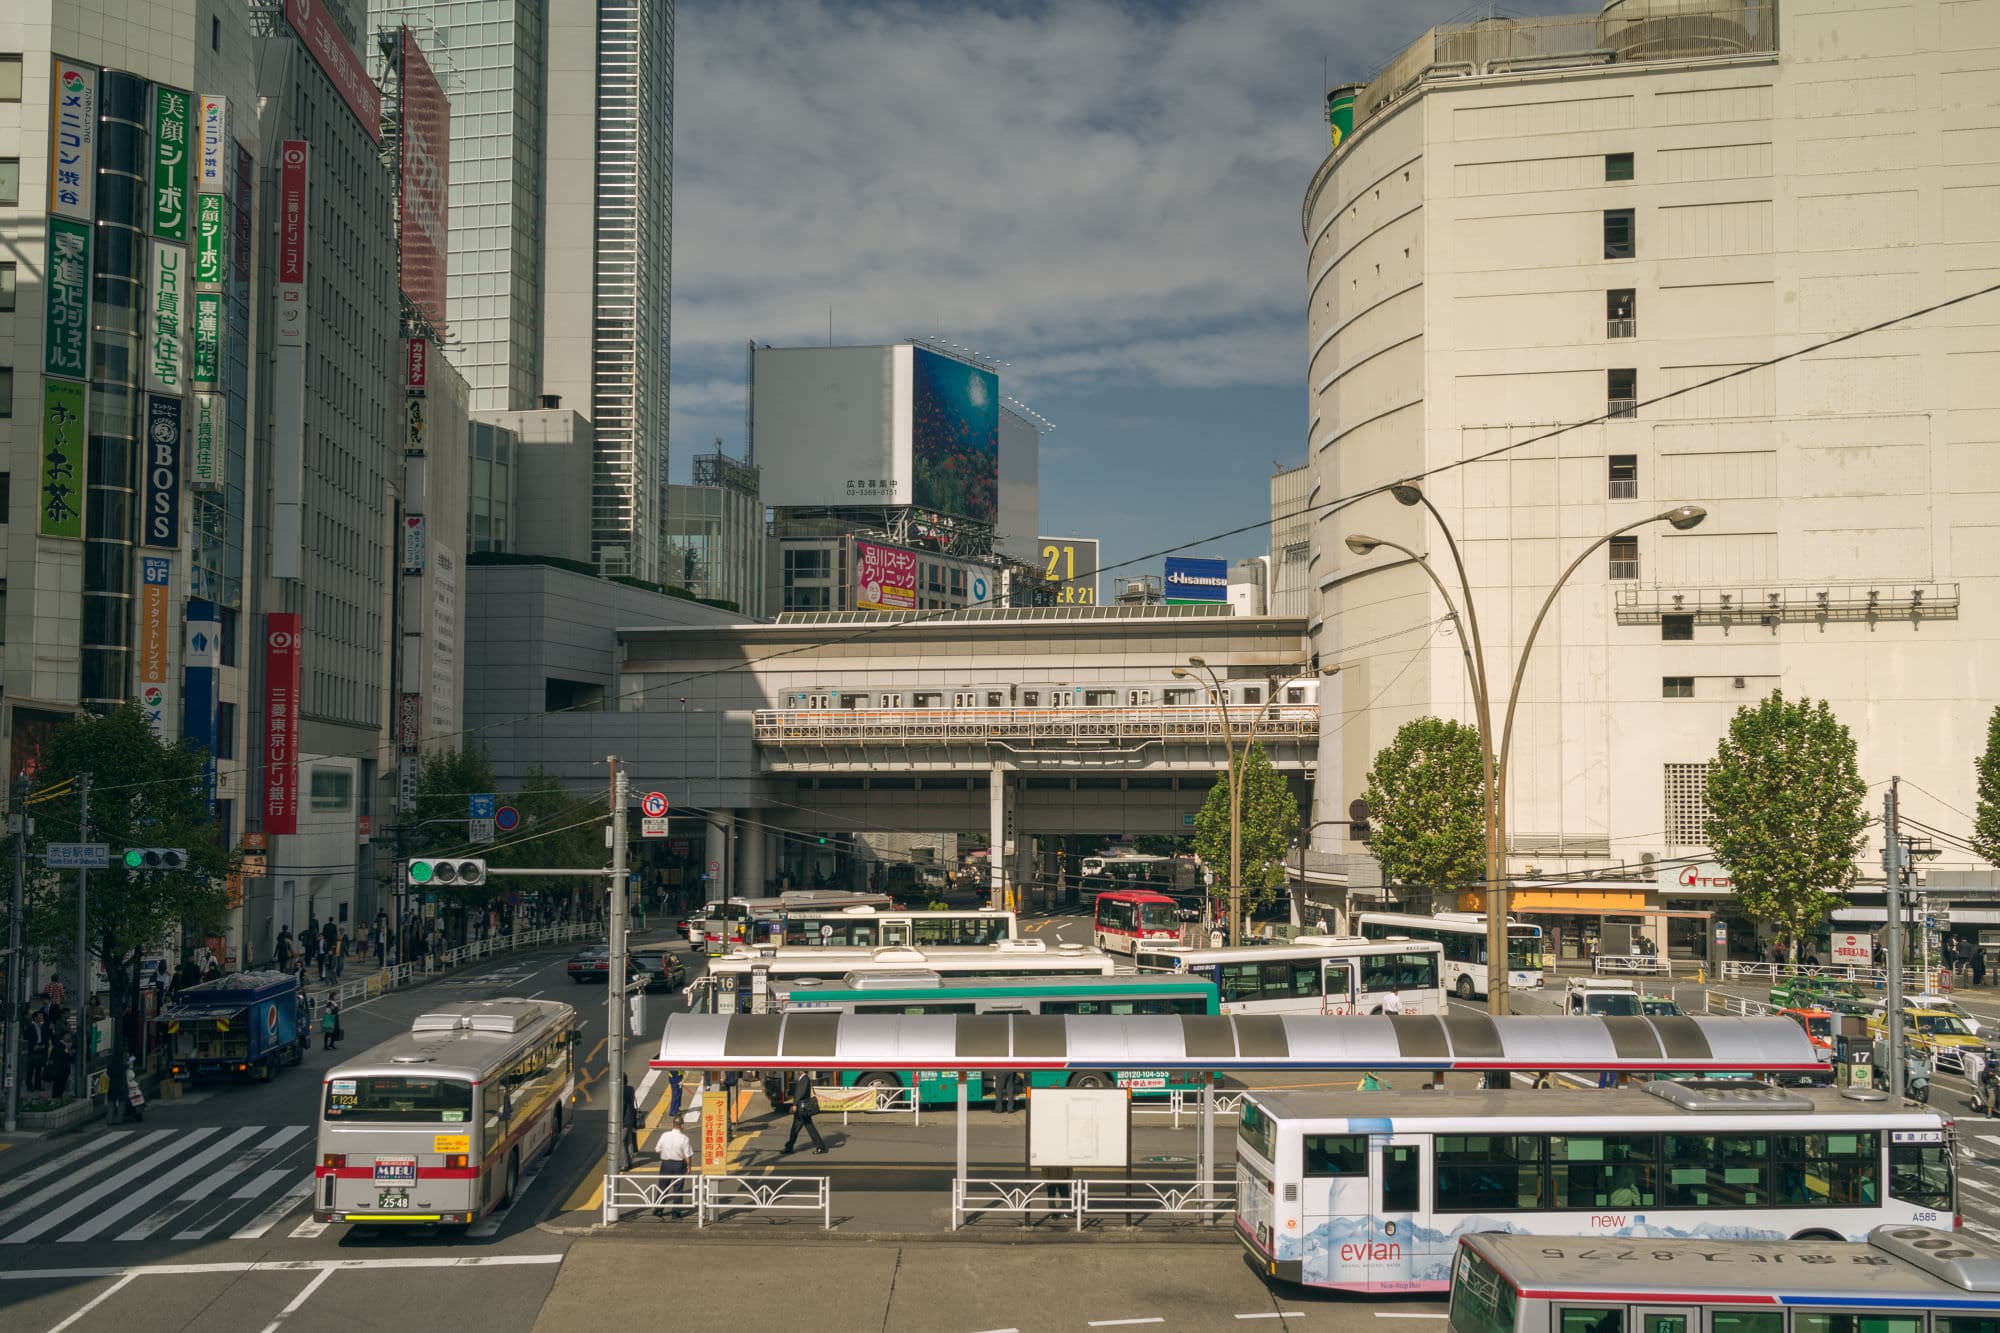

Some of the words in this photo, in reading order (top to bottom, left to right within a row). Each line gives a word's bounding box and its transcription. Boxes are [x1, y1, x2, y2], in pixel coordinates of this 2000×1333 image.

[59, 95, 81, 205] メニコン渋谷
[53, 231, 86, 289] 東進
[154, 250, 179, 385] UR賃貸住宅
[412, 342, 423, 382] カラオケ
[153, 444, 174, 538] BOSS
[865, 546, 915, 571] 品川スキン
[1042, 545, 1075, 582] 21
[146, 567, 168, 583] 9F
[866, 565, 915, 589] クリニック
[1167, 571, 1228, 587] Hisamitsu
[1078, 587, 1094, 604] 21
[149, 587, 160, 681] コンタクトレンズの
[268, 687, 287, 817] 三菱東京UFJ銀行
[720, 977, 734, 989] 16
[1852, 1051, 1871, 1063] 17
[339, 1095, 359, 1105] 1234
[1590, 1213, 1627, 1229] new
[1912, 1212, 1937, 1222] A585
[1341, 1239, 1401, 1262] evian
